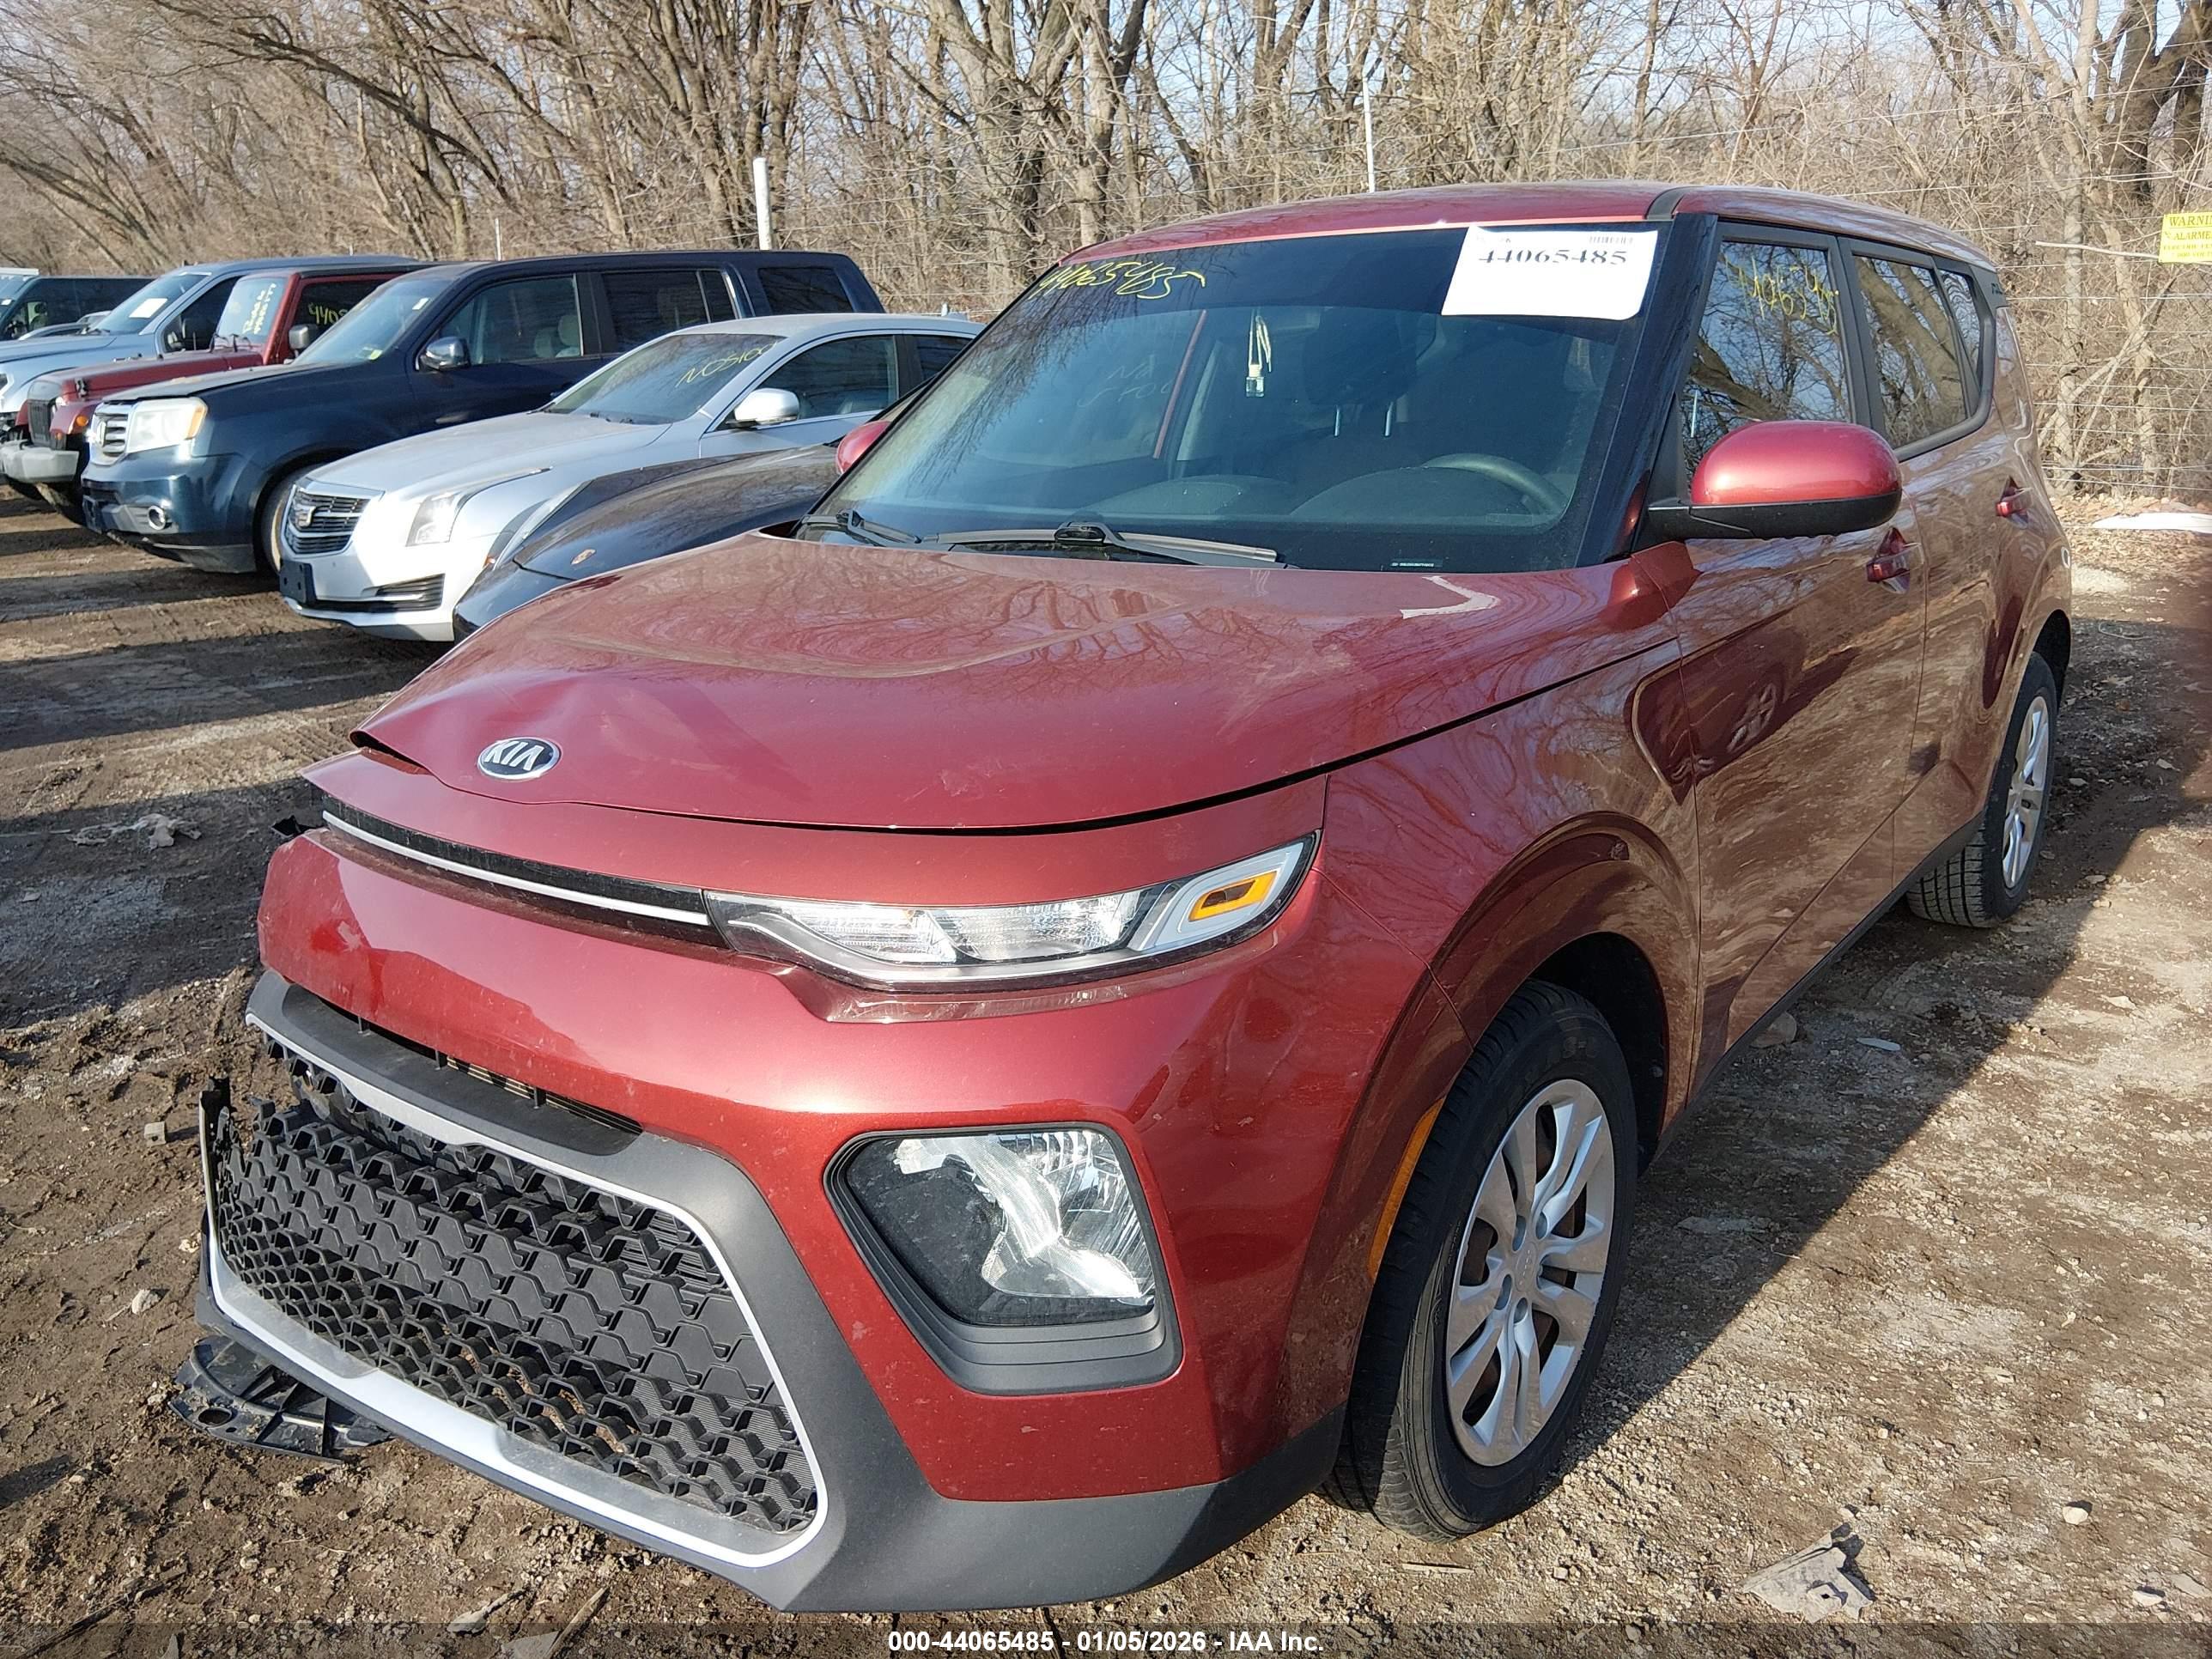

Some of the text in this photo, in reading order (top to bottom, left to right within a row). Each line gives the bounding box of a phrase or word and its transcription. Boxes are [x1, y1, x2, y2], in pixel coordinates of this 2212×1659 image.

[1479, 249, 1627, 265] 44065485
[1028, 260, 1206, 300] 44065485
[484, 741, 544, 771] KIA
